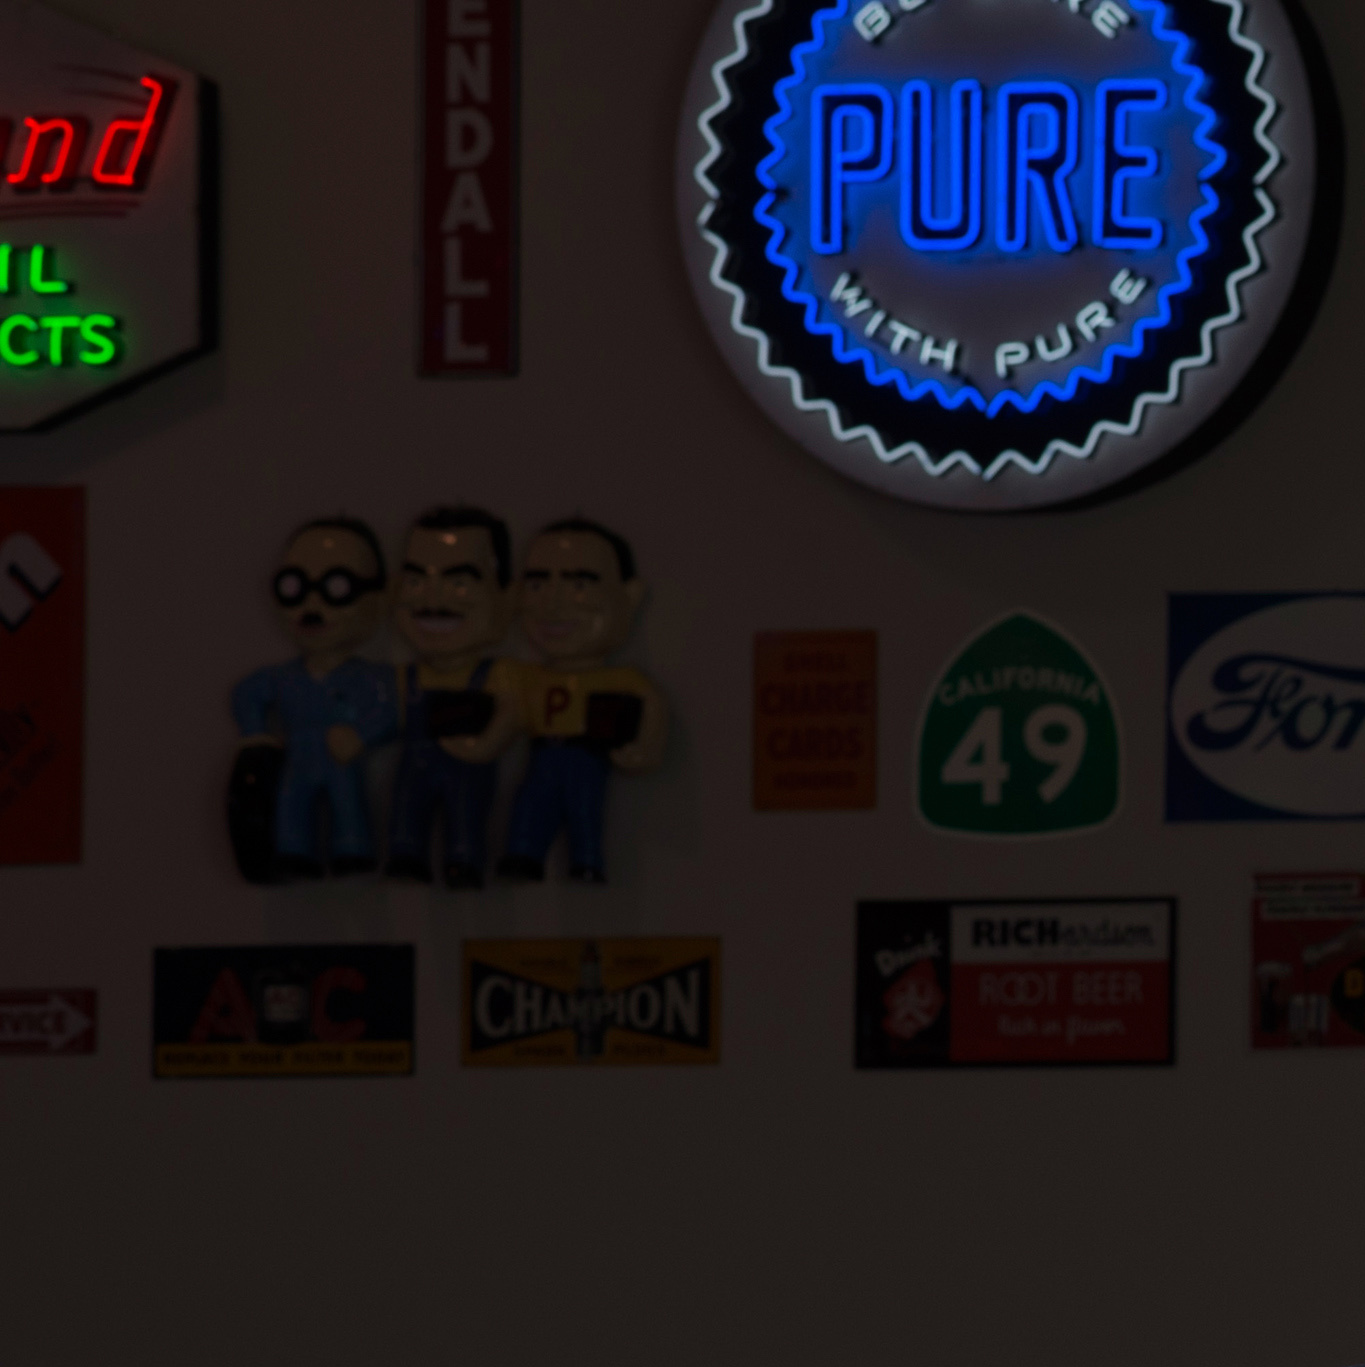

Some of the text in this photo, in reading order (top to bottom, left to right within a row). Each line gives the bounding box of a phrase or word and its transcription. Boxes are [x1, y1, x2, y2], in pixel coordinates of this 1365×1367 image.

[0, 73, 178, 190] nd
[810, 78, 1167, 255] PURE
[0, 313, 118, 366] CTS
[829, 268, 1152, 377] WITH PURE
[545, 689, 572, 728] P
[760, 681, 870, 715] CHARGE
[938, 665, 1101, 707] CALIFORNIA
[766, 727, 863, 760] CARDS
[940, 703, 1088, 806] 49
[474, 966, 701, 1041] CHAMPION
[979, 969, 1145, 1008] ROOT BEER
